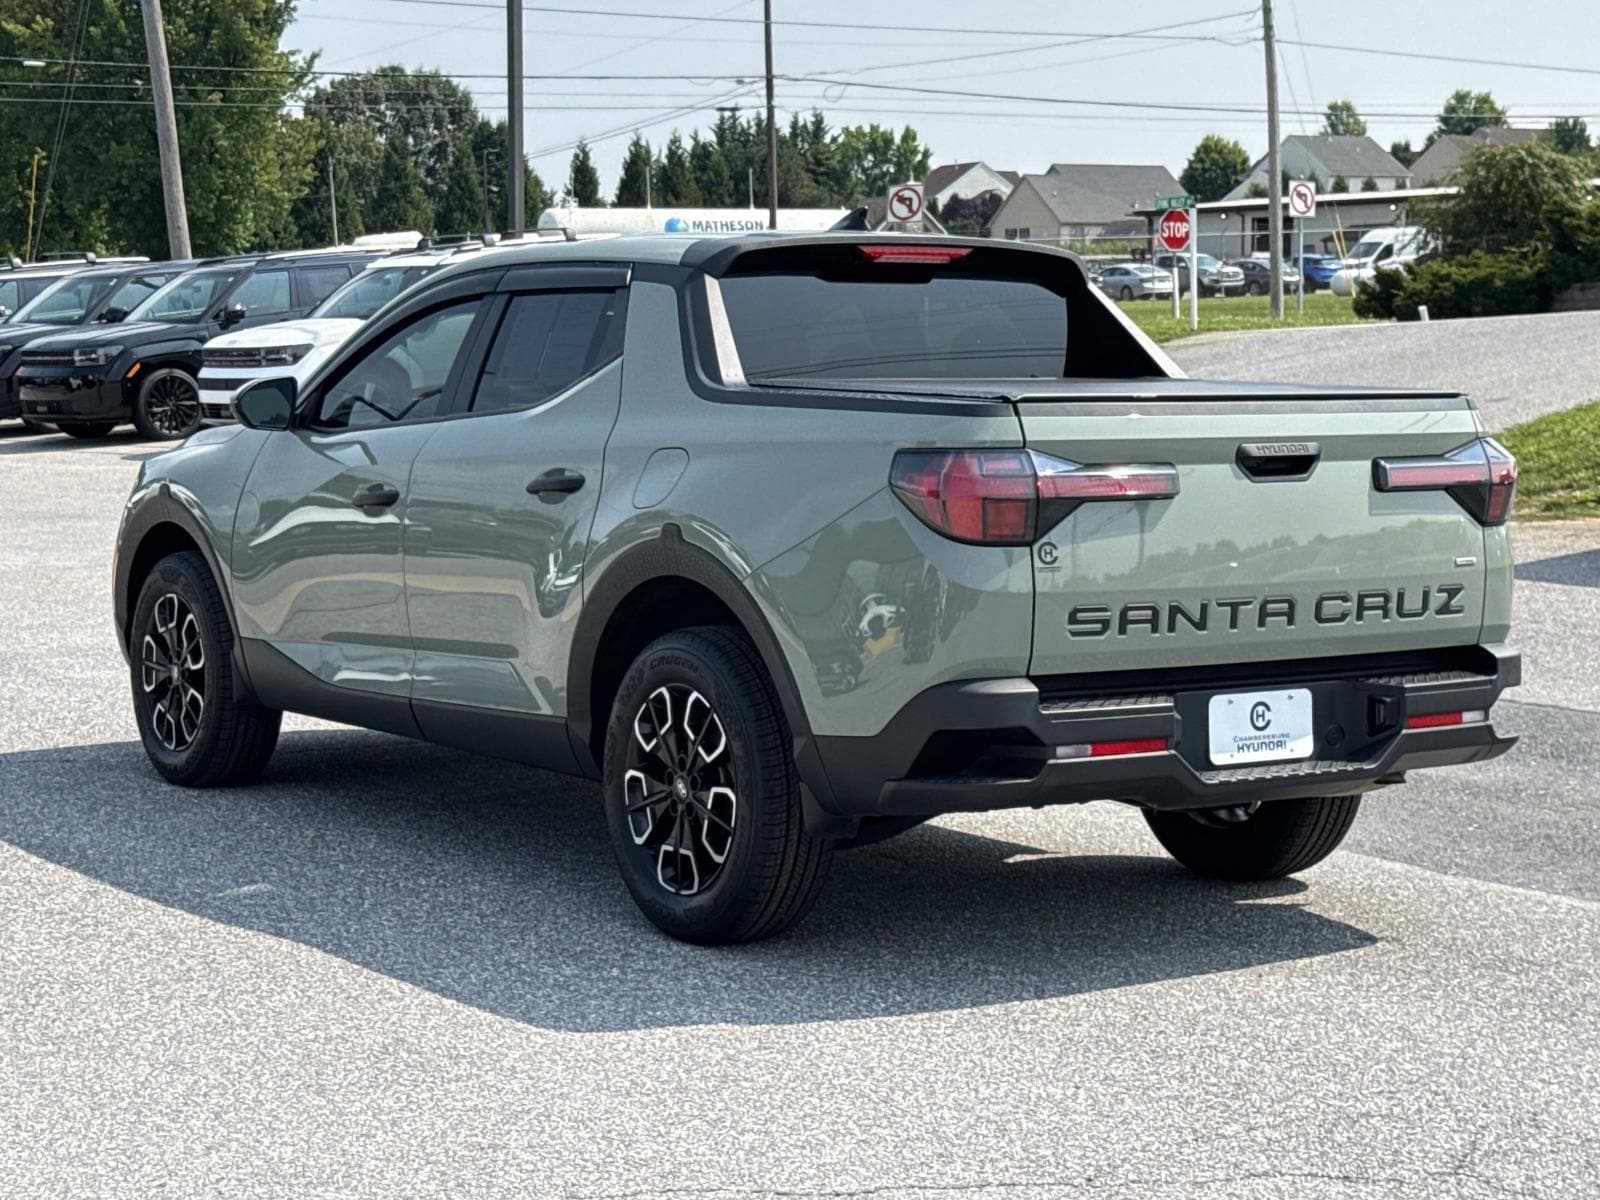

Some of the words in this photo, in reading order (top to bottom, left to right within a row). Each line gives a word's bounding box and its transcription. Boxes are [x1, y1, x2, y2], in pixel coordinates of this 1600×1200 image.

[692, 219, 764, 232] MATHESON
[1162, 221, 1189, 238] STOP
[1256, 444, 1309, 454] HYUNDAI
[1067, 595, 1297, 639] SANTA
[1314, 584, 1464, 625] CRUZ
[1237, 740, 1287, 753] HYUNDAI
